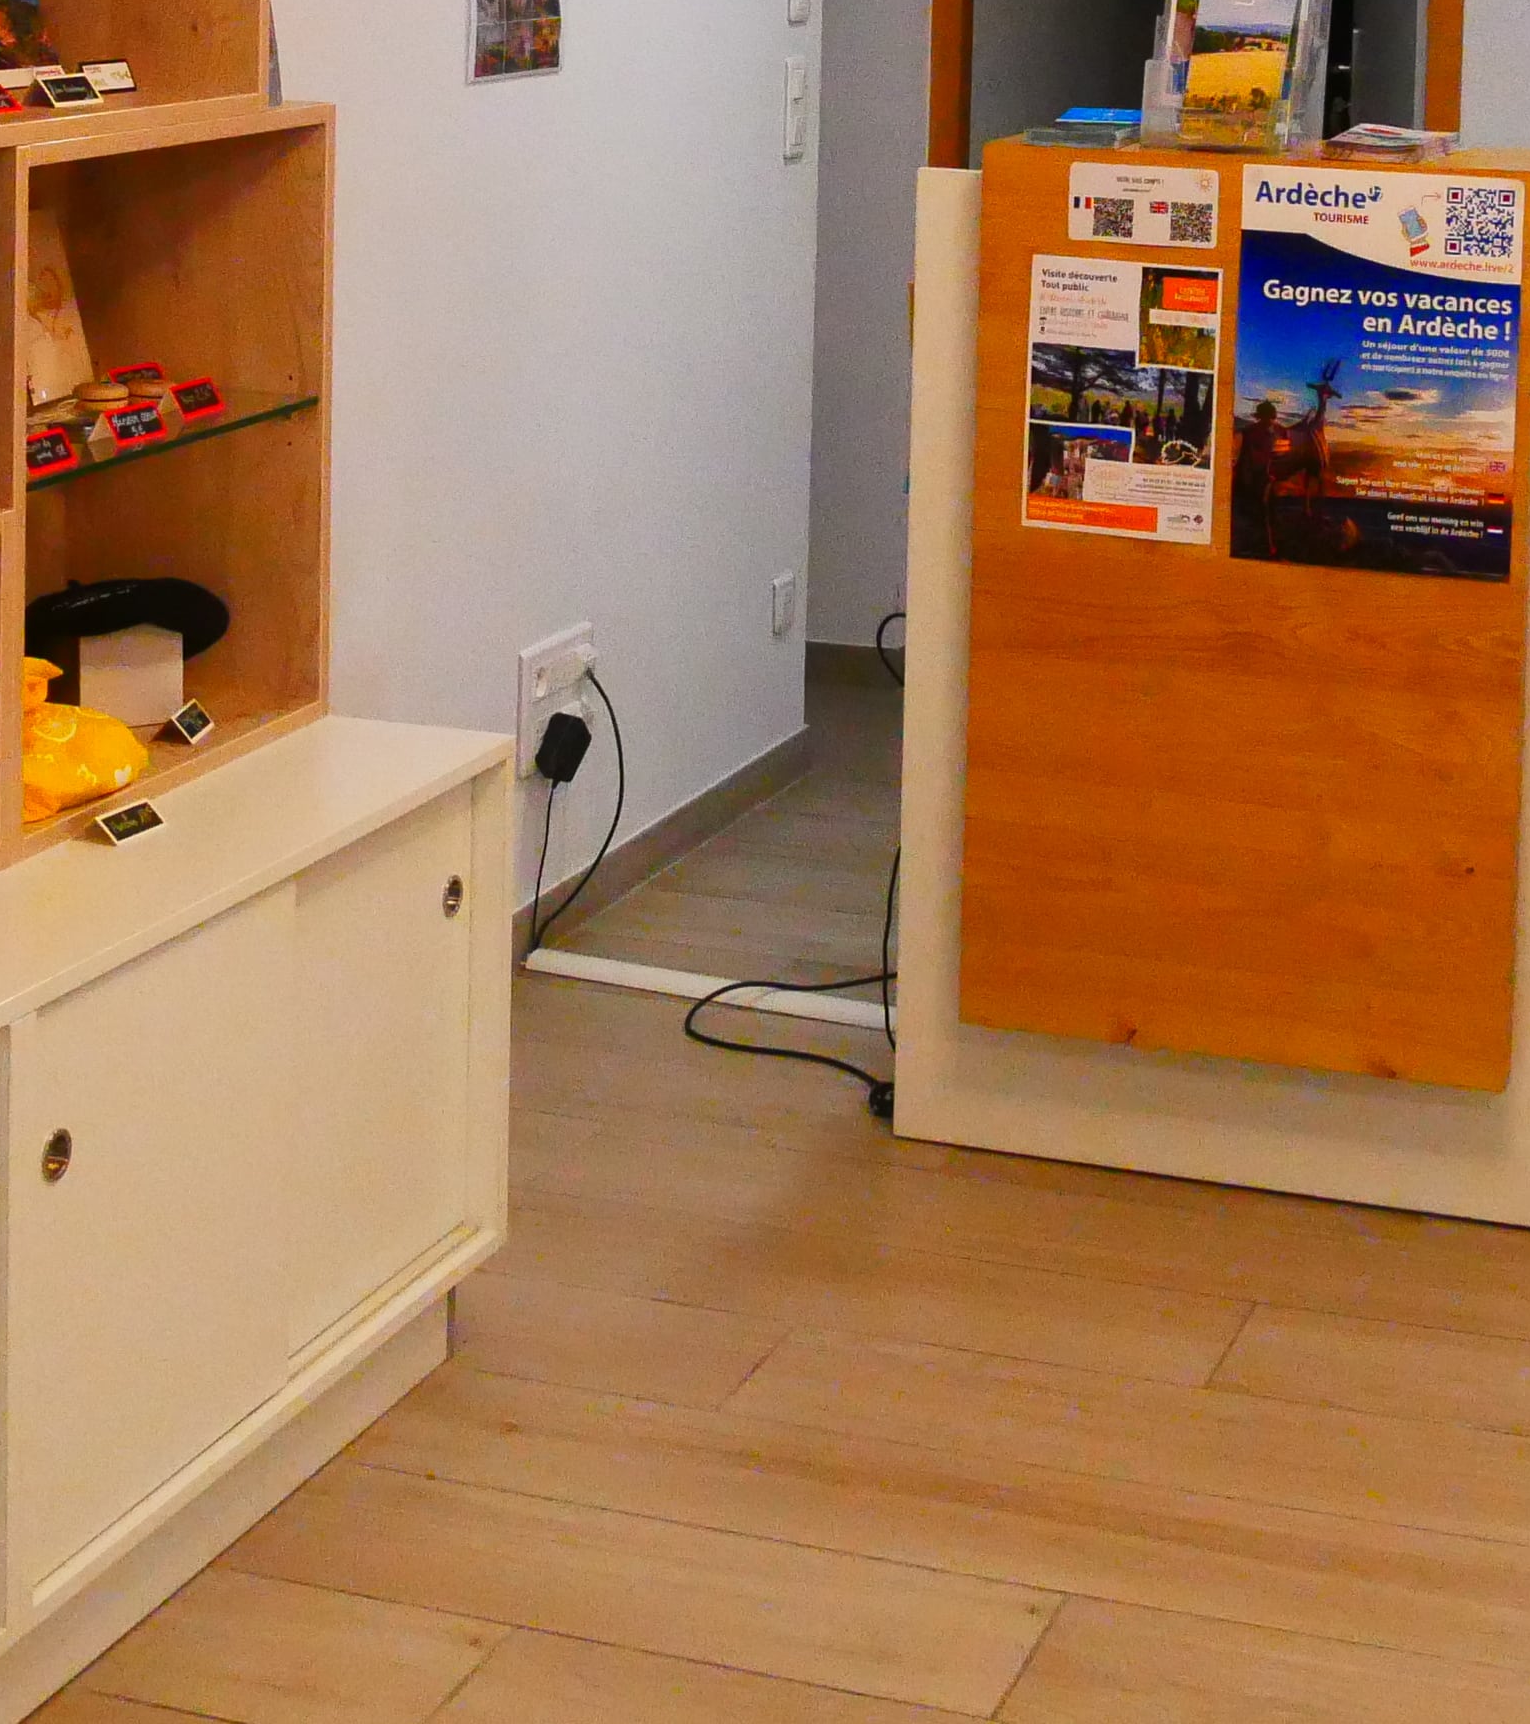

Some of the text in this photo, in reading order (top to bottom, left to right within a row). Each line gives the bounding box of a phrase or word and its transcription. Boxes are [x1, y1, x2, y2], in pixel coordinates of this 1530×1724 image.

[1256, 180, 1367, 209] Ardèche
[1313, 211, 1369, 225] TOURISME
[1410, 258, 1514, 274] www.ardeche.live/2
[1042, 268, 1118, 282] Visite découverte
[1041, 280, 1089, 292] Tout public
[1263, 279, 1512, 315] Gagnez vos vacances
[1363, 314, 1511, 341] en Ardèche !
[1362, 340, 1375, 348] Un
[1377, 341, 1408, 351] séjour
[1409, 343, 1437, 352] d'une
[1439, 346, 1469, 355] valeur
[1471, 347, 1483, 356] de
